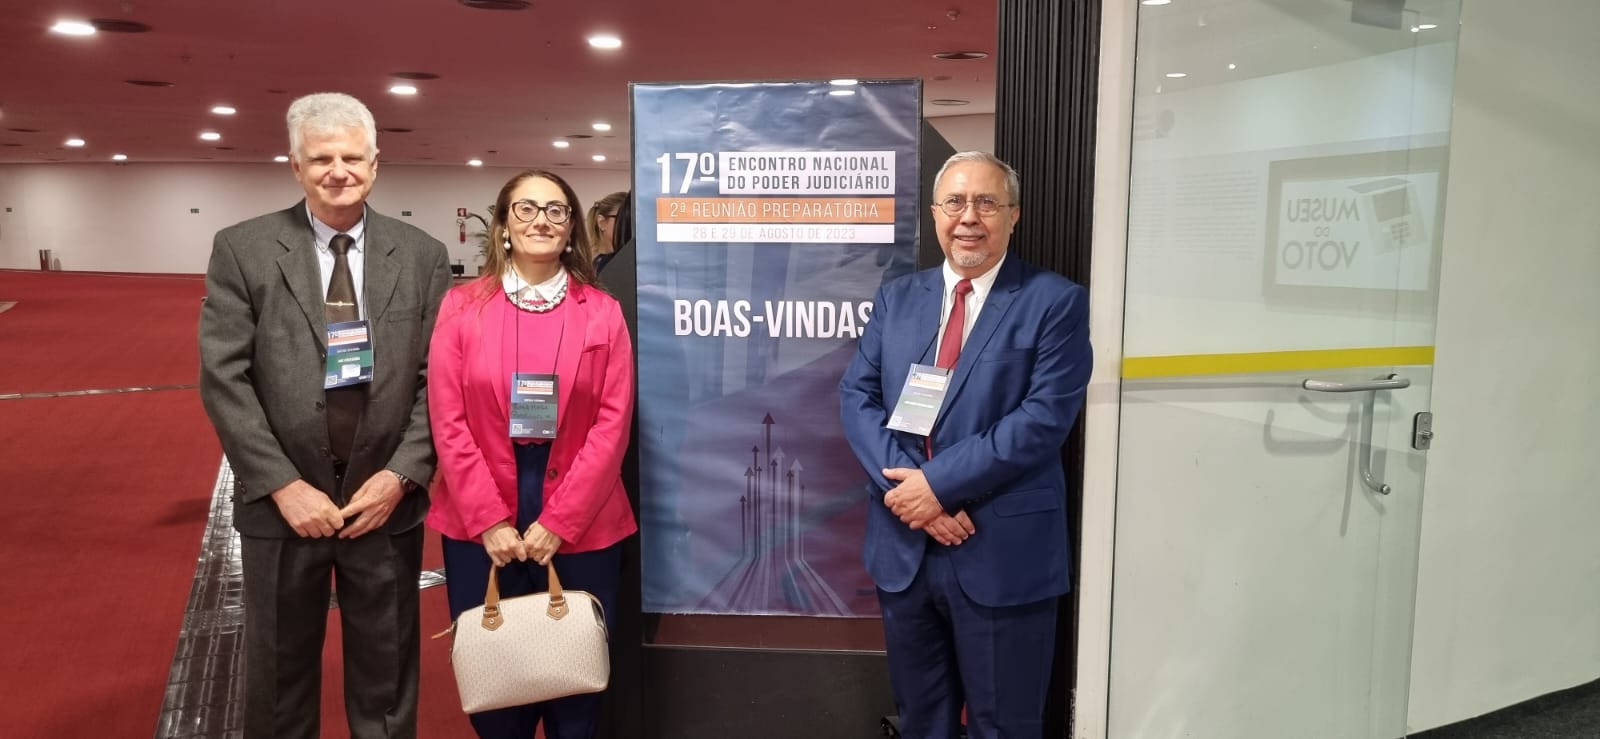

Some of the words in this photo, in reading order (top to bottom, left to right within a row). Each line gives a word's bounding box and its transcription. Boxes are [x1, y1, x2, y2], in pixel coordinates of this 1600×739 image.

[728, 156, 806, 172] ENCONTRO
[813, 156, 889, 172] NACIONAL
[727, 175, 746, 190] DO
[752, 175, 799, 190] PODER
[806, 171, 890, 190] JUDICIÁRIO
[692, 199, 757, 218] REUNIÃO
[763, 200, 878, 218] PREPARATÓRIA
[711, 227, 717, 239] E
[759, 227, 804, 240] AGOSTO
[808, 228, 823, 240] DE
[826, 227, 856, 240] 2023
[674, 299, 874, 338] BOAS-VINDAS
